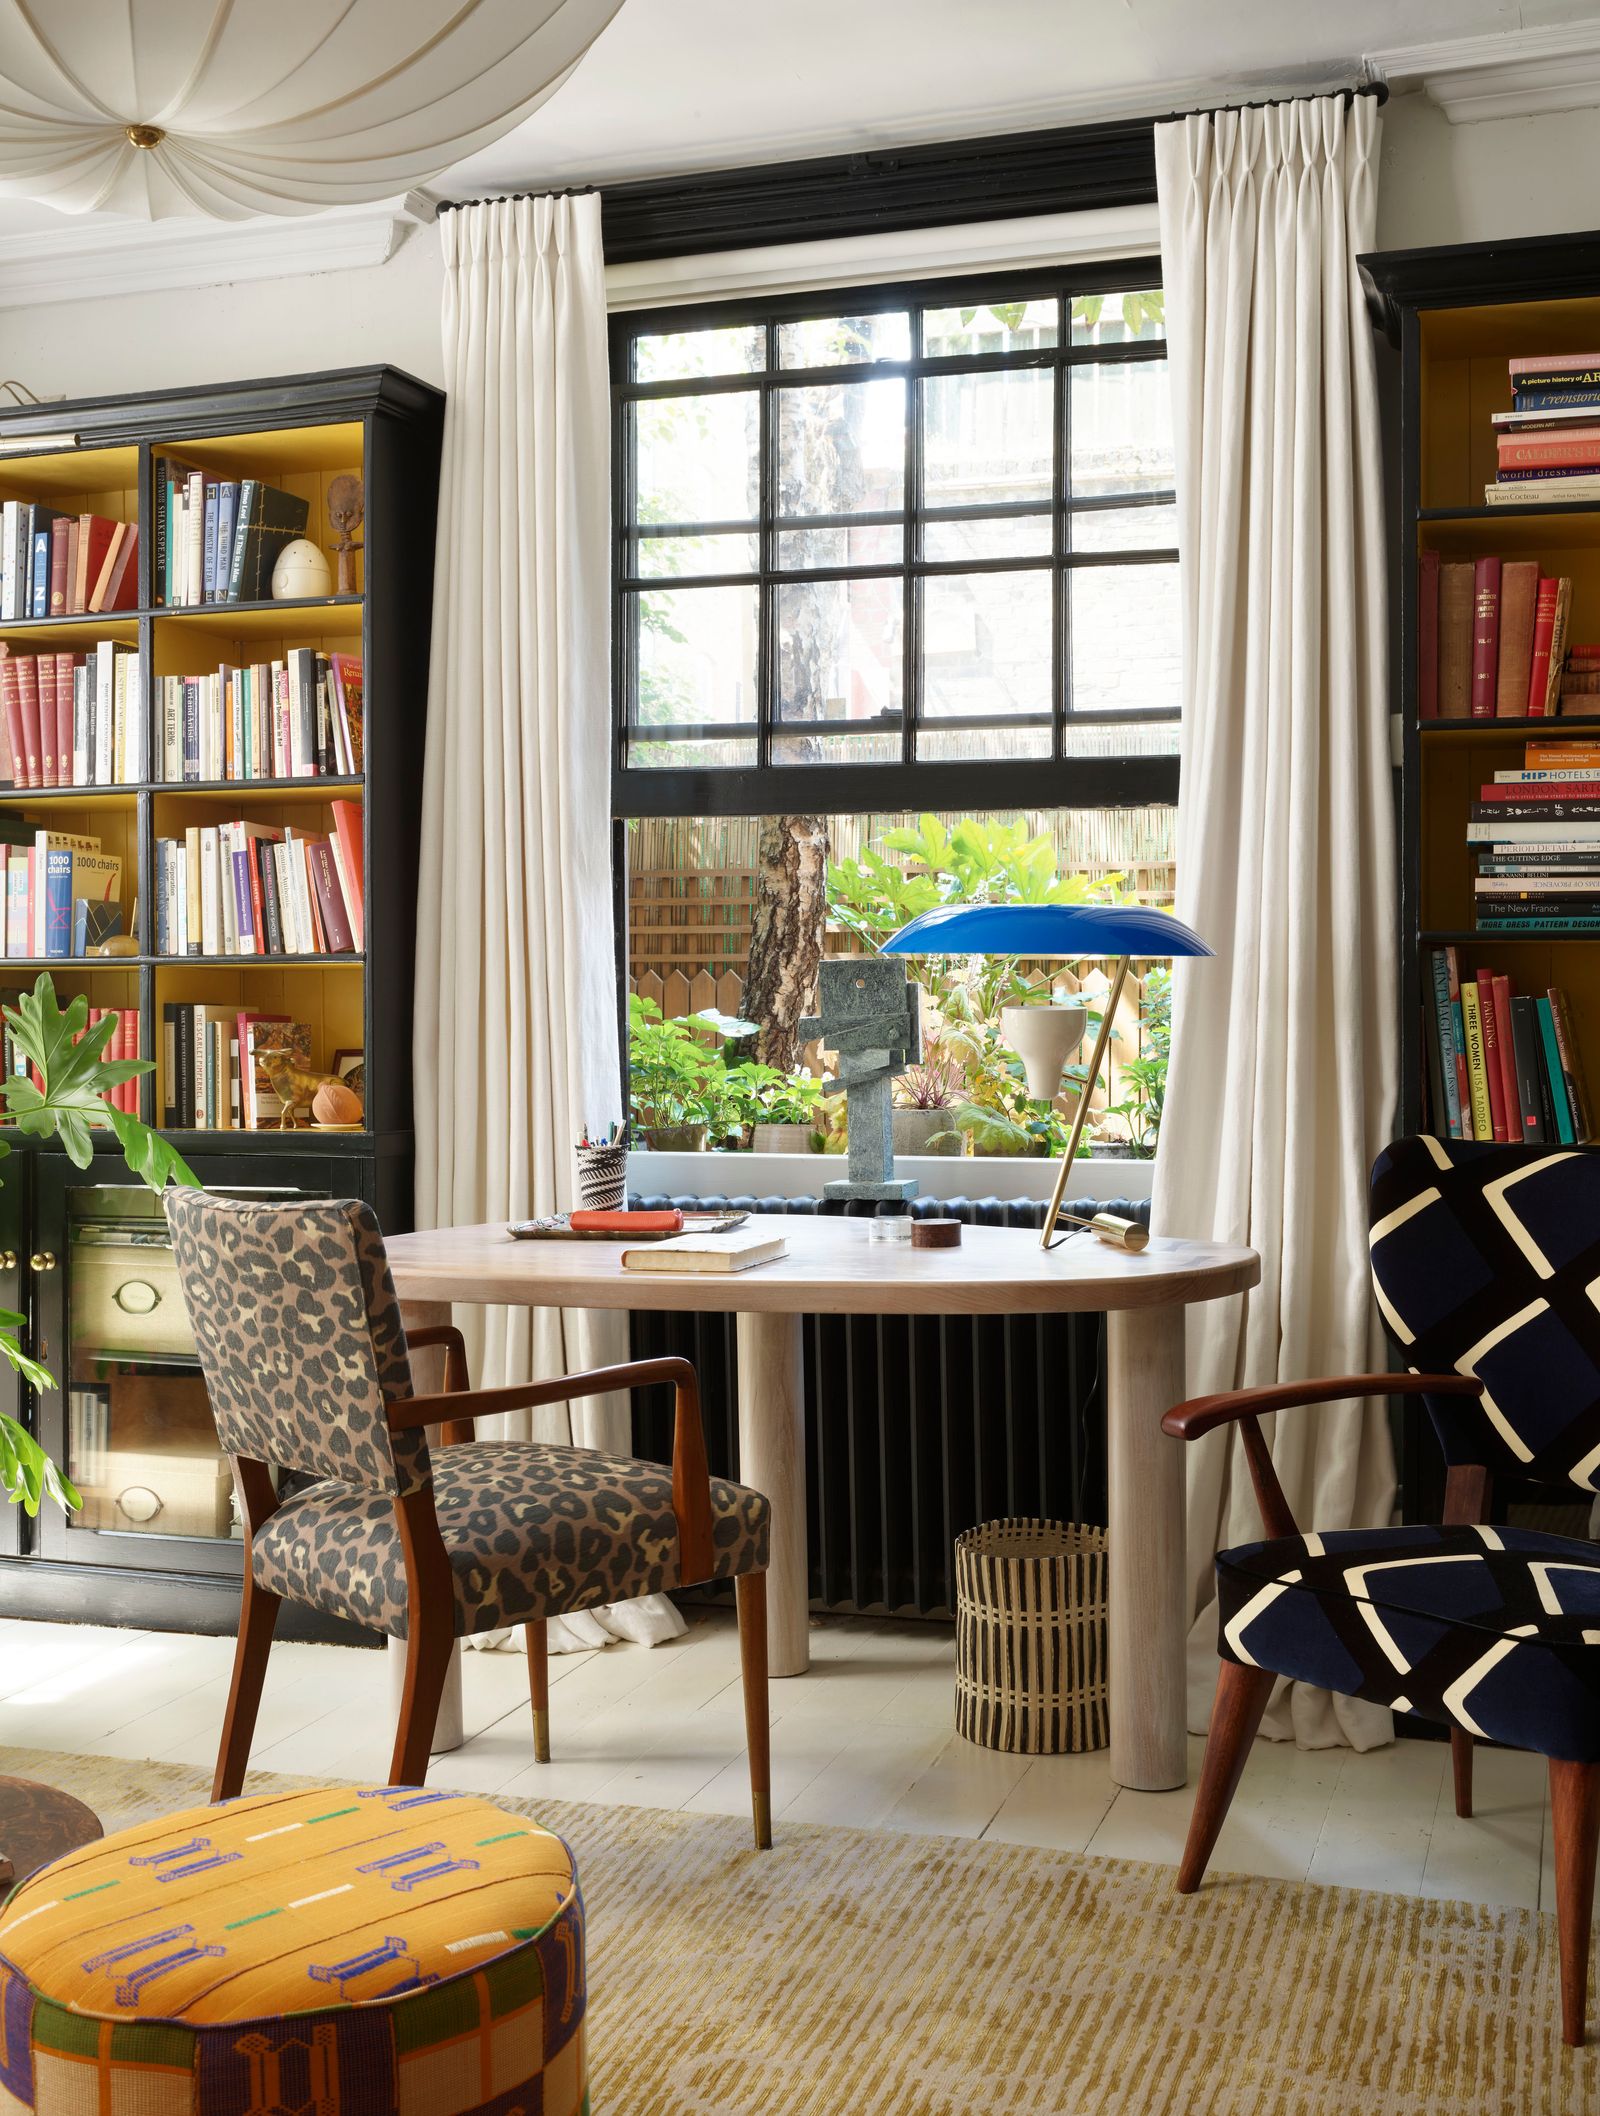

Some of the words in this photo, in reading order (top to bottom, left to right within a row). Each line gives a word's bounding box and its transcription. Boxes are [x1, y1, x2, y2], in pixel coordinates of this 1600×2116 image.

[1502, 470, 1533, 479] world
[1537, 469, 1567, 478] dress
[207, 488, 216, 499] H
[222, 486, 232, 497] A
[242, 485, 251, 505] Primo
[1495, 494, 1509, 502] Jean
[1510, 493, 1540, 501] Cocteau
[206, 512, 214, 523] THE
[35, 538, 47, 553] A
[206, 527, 214, 553] MINISTRY
[221, 535, 229, 555] THIRD
[236, 542, 244, 555] This
[206, 568, 214, 583] FEAR
[232, 569, 240, 583] Man
[35, 586, 45, 601] Z
[217, 590, 227, 601] N
[167, 709, 175, 721] ART
[167, 723, 175, 746] TERMS
[1521, 772, 1548, 780] HIP
[1549, 771, 1591, 780] HOTELS
[1505, 784, 1560, 794] LONDON
[1500, 845, 1535, 853] PERIOD
[1537, 844, 1577, 852] DETAILS
[50, 856, 69, 866] 1000
[77, 857, 97, 869] 1000
[98, 860, 119, 871] chairs
[48, 865, 71, 874] chairs
[270, 907, 275, 916] MY
[1489, 904, 1506, 913] The
[1508, 904, 1529, 913] New
[1531, 904, 1560, 912] France
[1481, 921, 1504, 929] MORE
[1434, 957, 1448, 994] PAINT
[1438, 997, 1452, 1042] MAGIC
[1468, 1004, 1478, 1030] THREE
[1484, 1000, 1497, 1048] PAINTING
[1471, 1033, 1481, 1070] WOMEN
[1474, 1074, 1484, 1092] LISA
[1477, 1096, 1487, 1132] TADDEO
